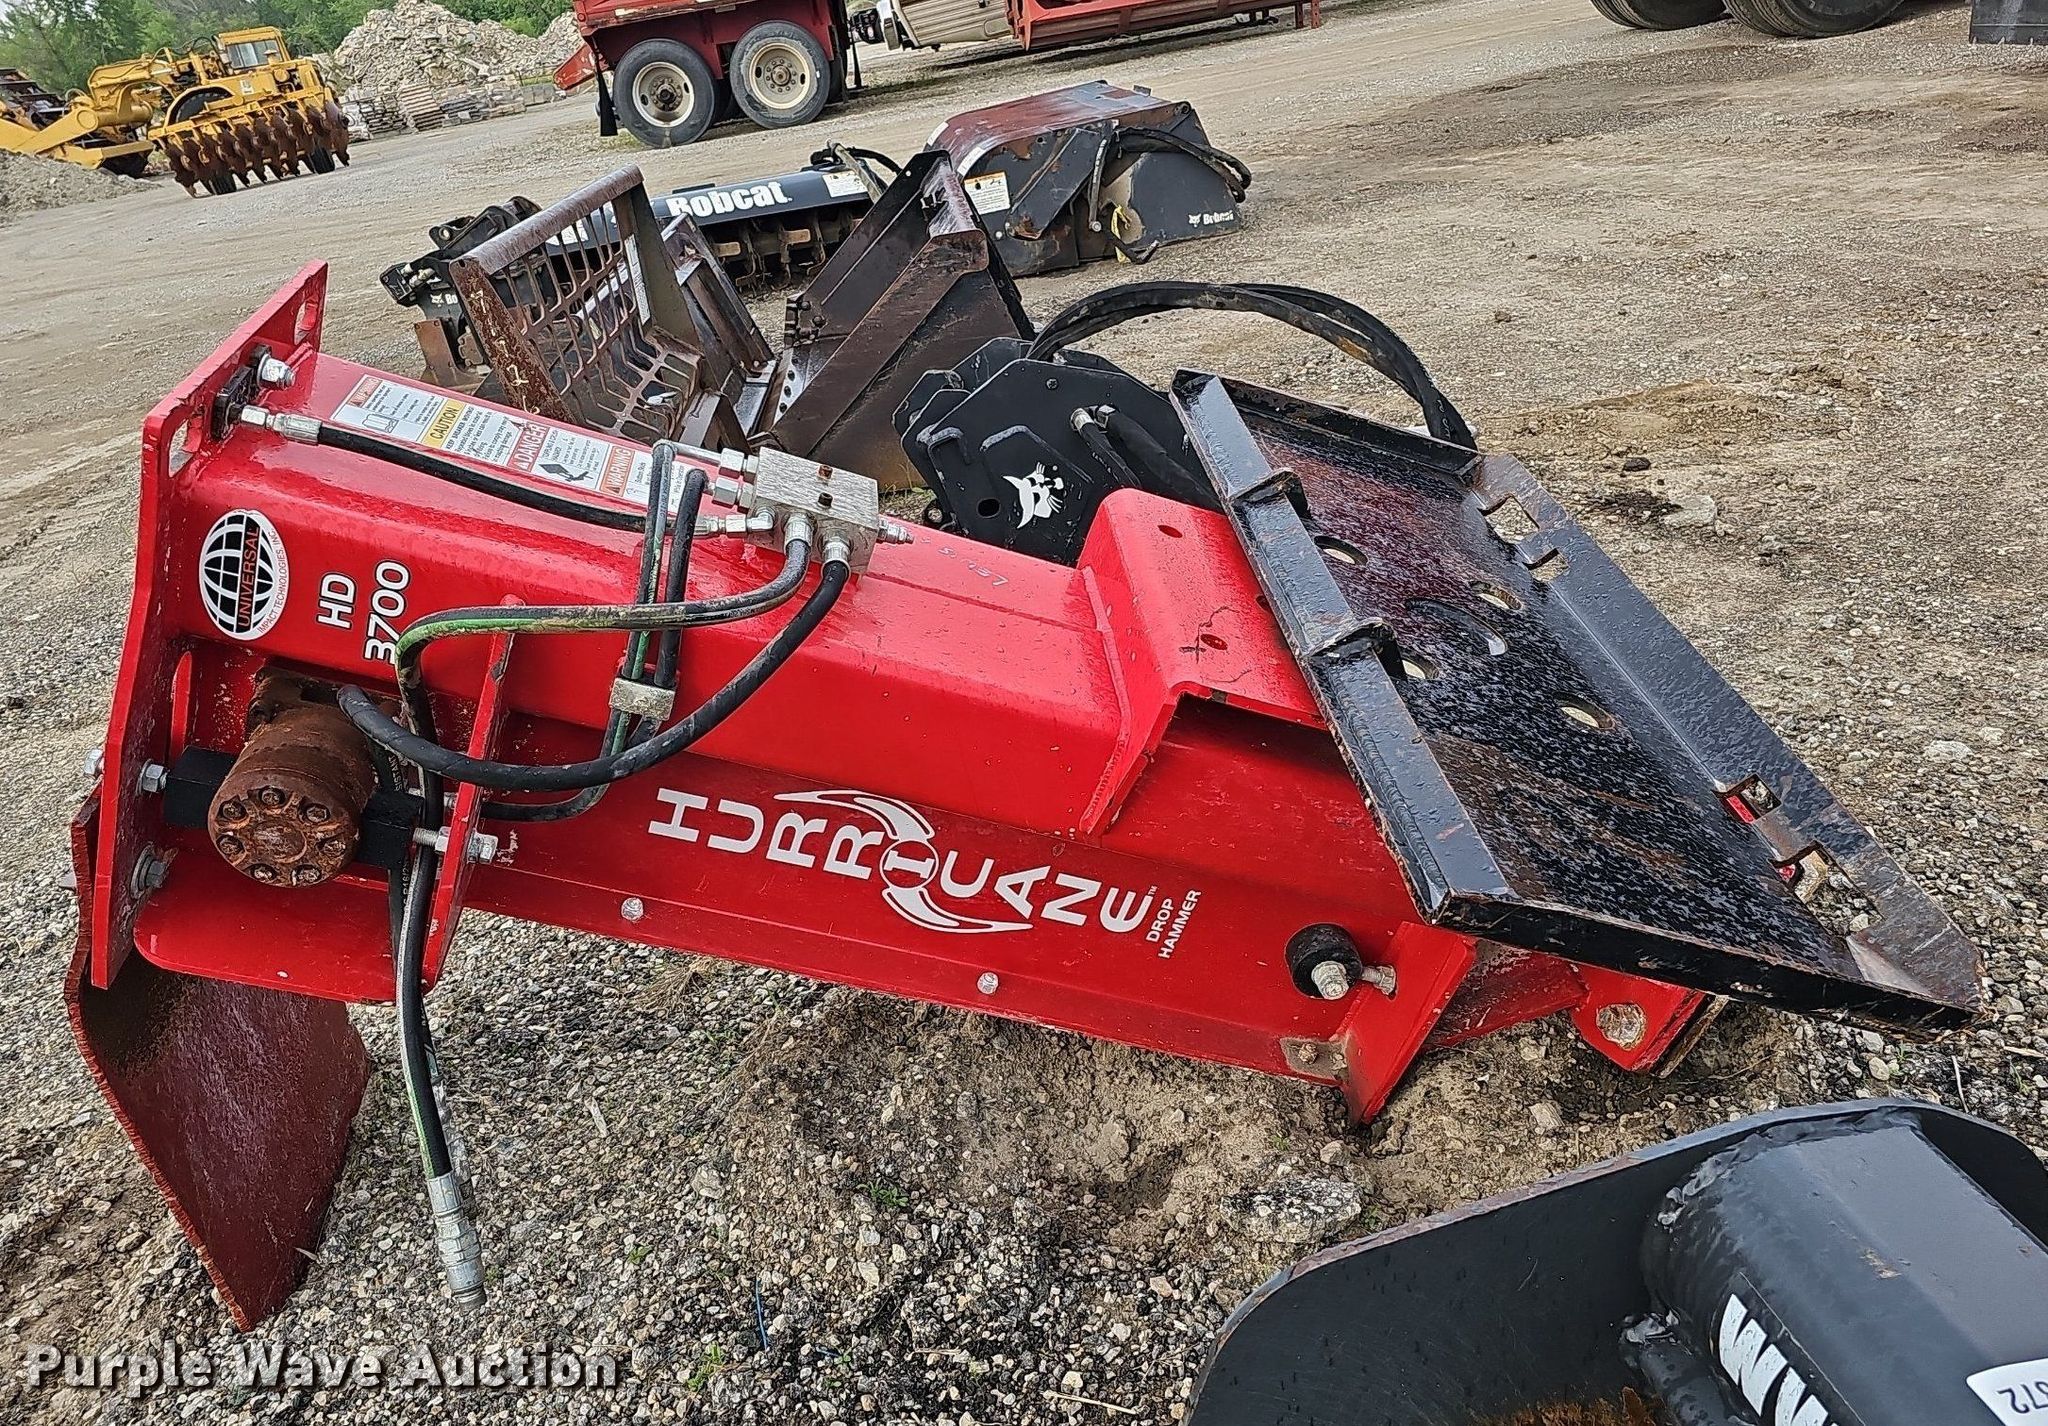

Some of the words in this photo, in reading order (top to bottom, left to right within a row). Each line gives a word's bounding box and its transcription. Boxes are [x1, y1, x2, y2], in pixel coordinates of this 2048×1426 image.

[430, 407, 460, 440] CAUTION
[519, 424, 548, 463] DANGER
[608, 447, 633, 486] WARNING
[236, 526, 260, 627] UNIVERSAL
[257, 609, 277, 634] IMPACT
[317, 573, 356, 629] HD
[363, 561, 410, 665] 3700
[388, 755, 402, 792] SISTANT
[648, 788, 1153, 932] HURRICANE
[1145, 898, 1174, 942] DROP
[1157, 890, 1202, 959] HAMMER
